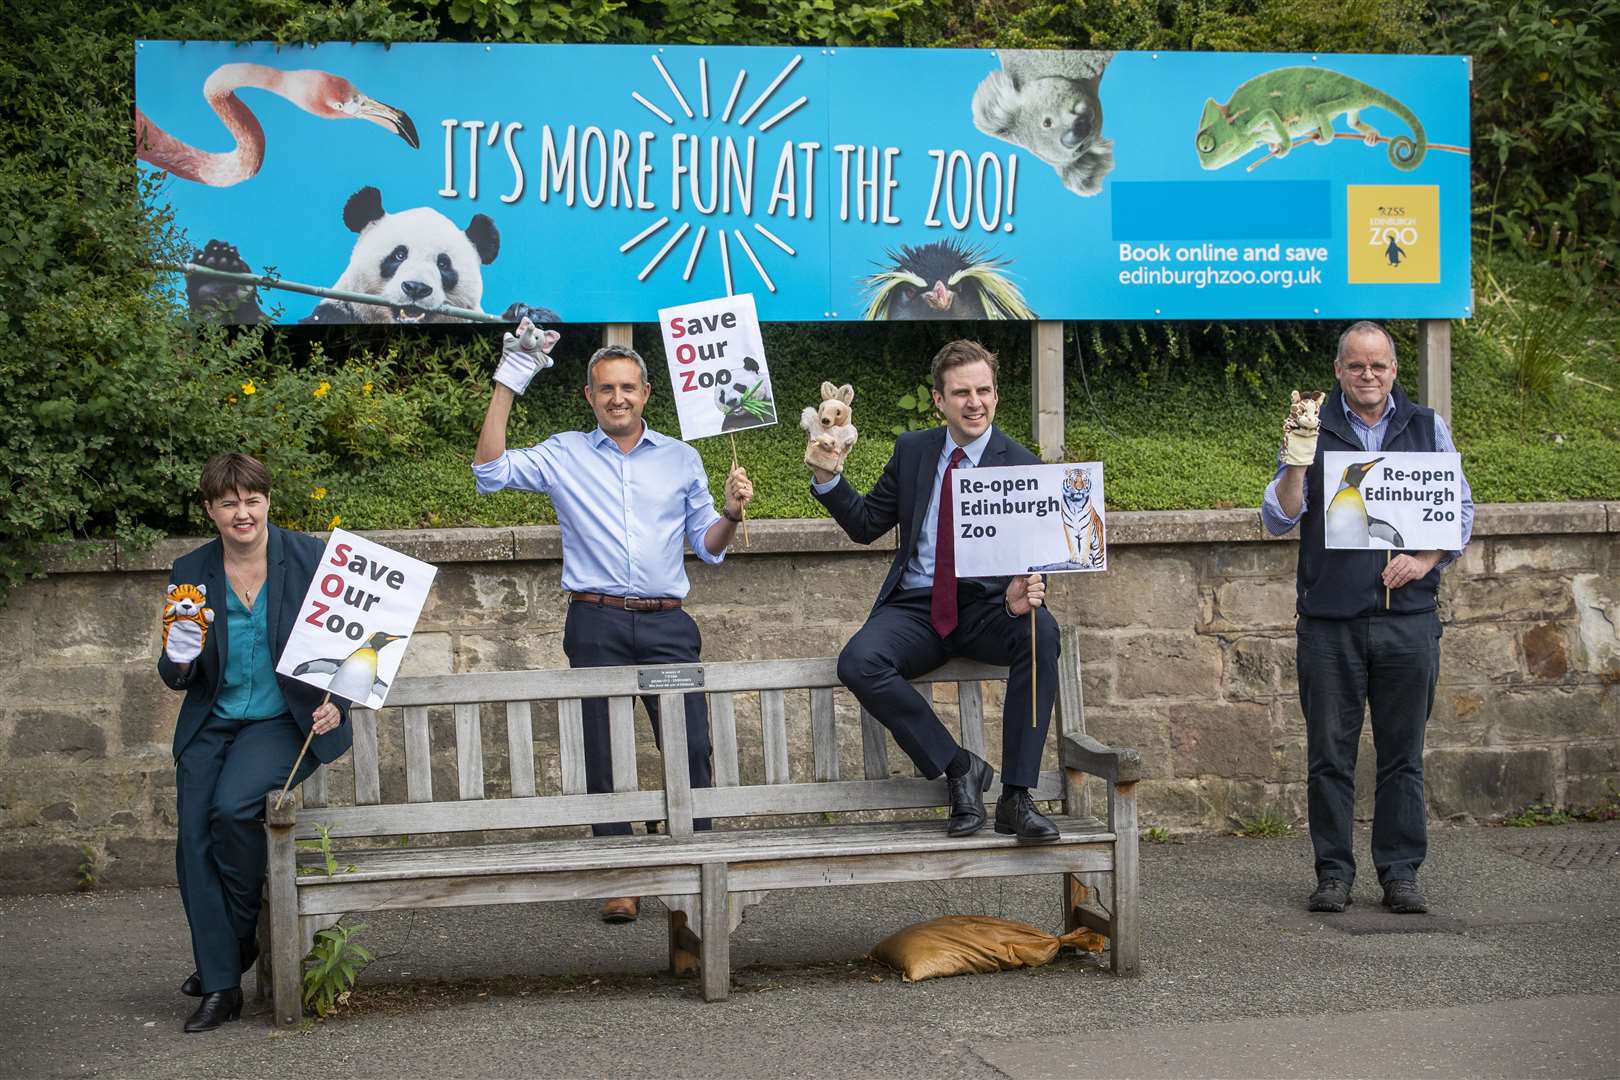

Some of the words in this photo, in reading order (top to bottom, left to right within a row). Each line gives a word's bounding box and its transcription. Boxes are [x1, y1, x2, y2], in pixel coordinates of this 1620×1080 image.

[438, 118, 525, 203] IT'S
[540, 124, 656, 209] MORE
[672, 132, 756, 215] FUN
[767, 140, 821, 220] AT
[833, 143, 901, 224] THE
[924, 148, 1018, 233] ZOO!
[1369, 227, 1418, 246] ZOO
[1119, 243, 1171, 262] Book
[1176, 243, 1239, 262] online
[1243, 243, 1280, 262] and
[1285, 246, 1329, 262] save
[1119, 266, 1322, 288] edinburghzoo.org.uk
[670, 312, 737, 339] Save
[675, 340, 728, 365] Our
[679, 368, 732, 393] Zoo
[959, 477, 1039, 497] Re-open
[1383, 467, 1455, 486] Re-open
[960, 496, 1060, 517] Edinburgh
[1365, 486, 1455, 506] Edinburgh
[1422, 508, 1455, 522] Zoo
[960, 524, 997, 539] Zoo
[330, 543, 405, 591] Save
[320, 573, 381, 612] Our
[305, 600, 365, 641] Zoo
